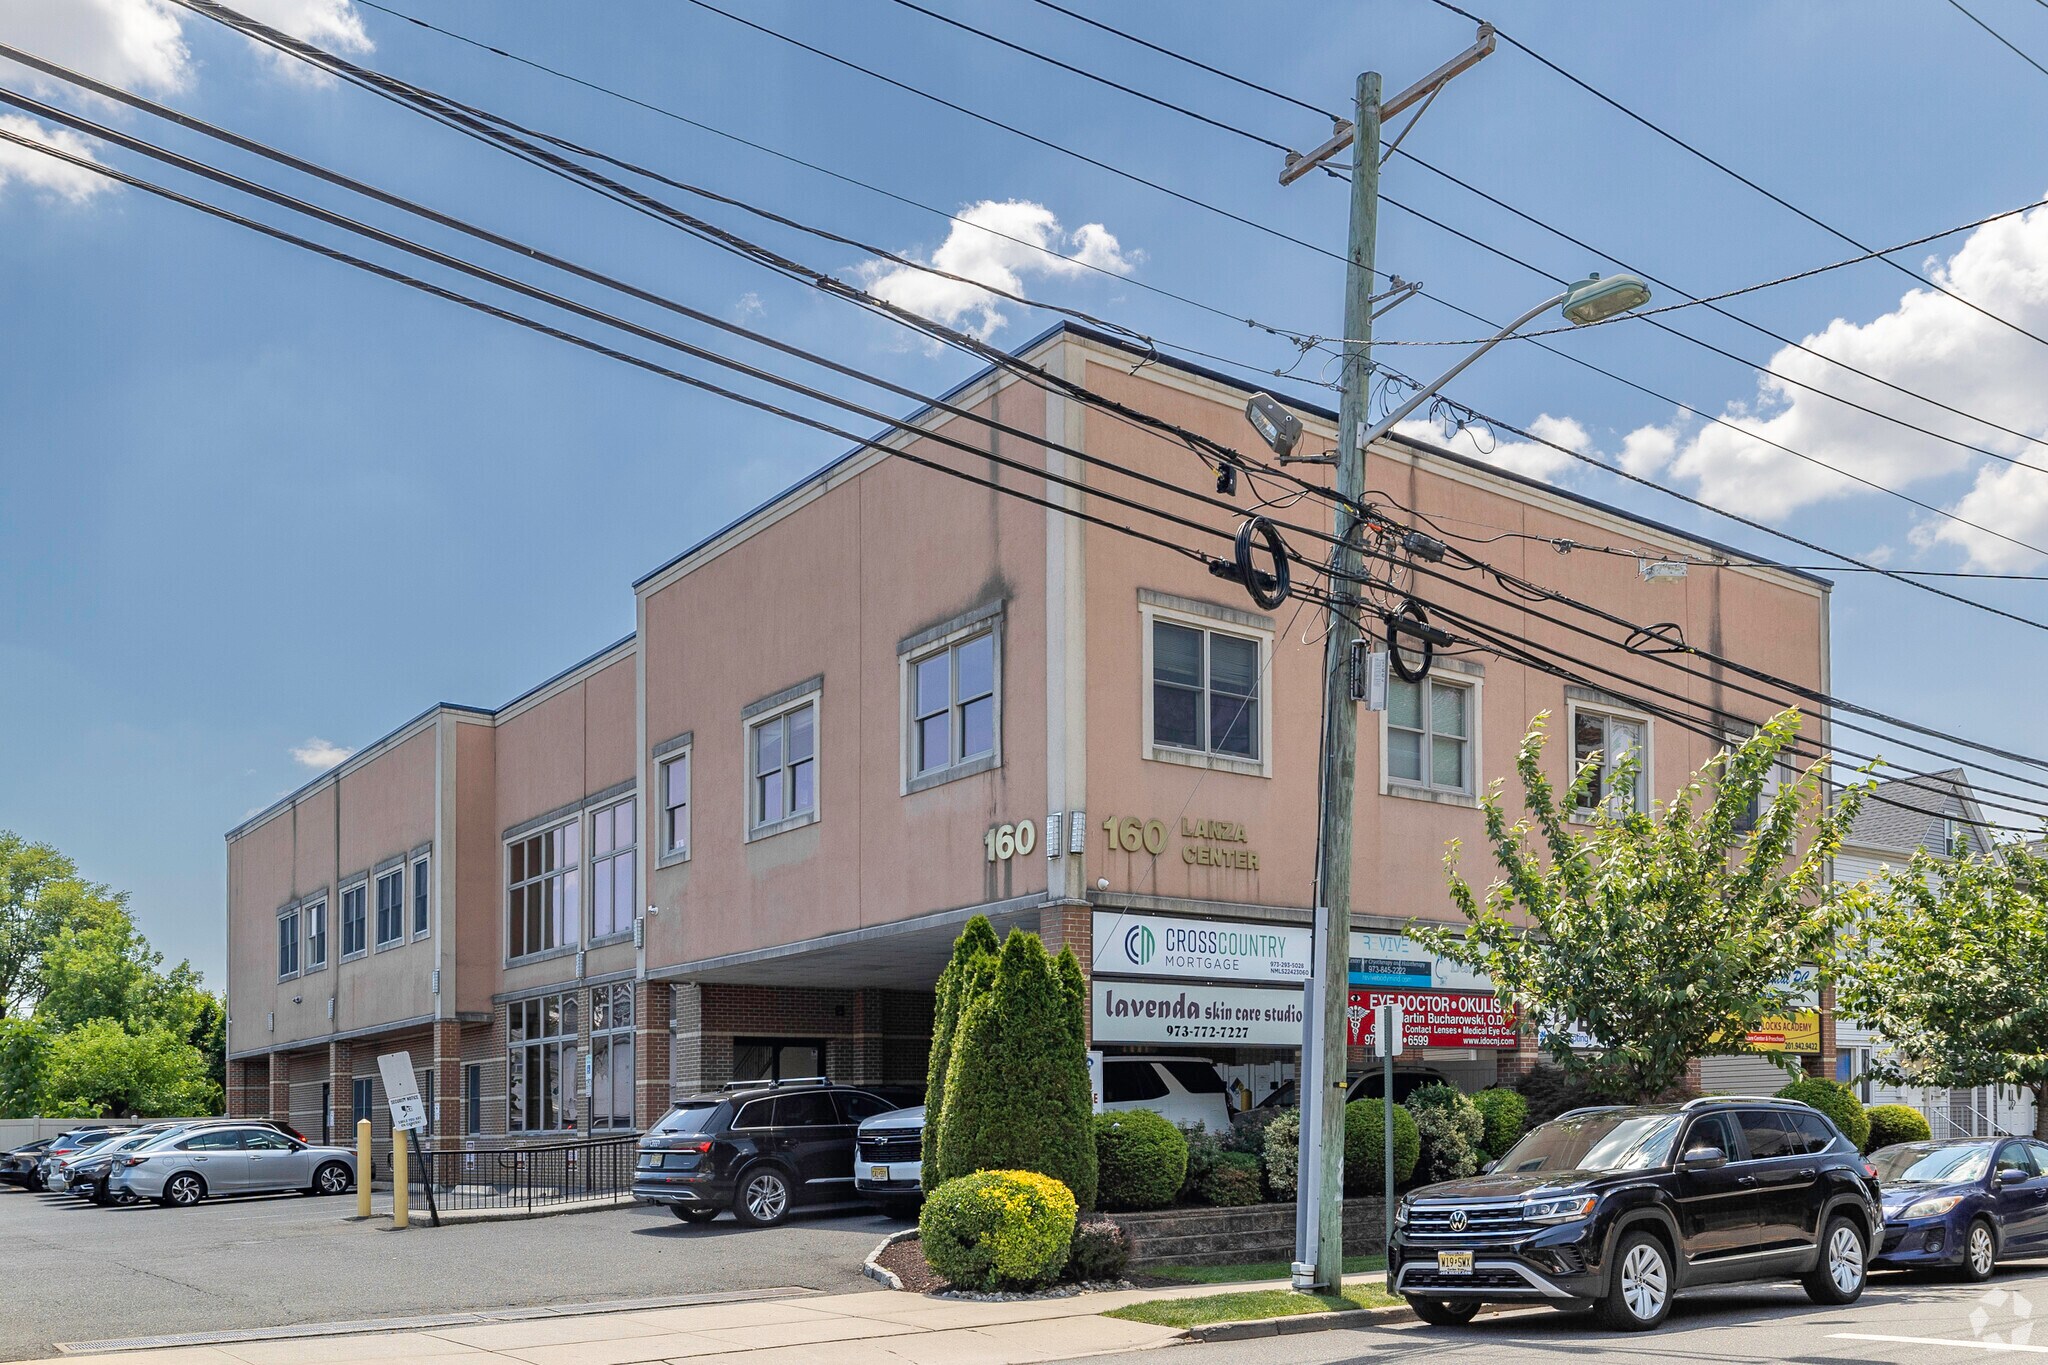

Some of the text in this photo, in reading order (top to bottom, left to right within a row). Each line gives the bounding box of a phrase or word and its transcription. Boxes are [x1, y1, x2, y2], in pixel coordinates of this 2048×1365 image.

[1103, 816, 1168, 854] 160
[1181, 817, 1247, 843] LANZA
[984, 819, 1037, 862] 160
[1182, 845, 1260, 870] CENTER
[1166, 928, 1286, 958] CROSSCOUNTRY
[1165, 956, 1240, 971] MORTGAGE
[1106, 990, 1302, 1022] lavenda skin care studio
[1398, 995, 1450, 1012] DOCTOR
[1402, 1013, 1425, 1023] artin
[1428, 1013, 1486, 1027] Bucharowski,
[1783, 1022, 1812, 1032] ACADEMY
[1167, 1025, 1249, 1038] 973-772-7227
[1405, 1025, 1431, 1034] Contact
[1434, 1026, 1457, 1035] Lenses
[1463, 1026, 1487, 1035] Medical
[1488, 1027, 1500, 1036] Eye
[1408, 1035, 1428, 1046] 6599
[1463, 1036, 1514, 1046] www.idocnj.com
[1785, 1041, 1818, 1050] 201.942.9422
